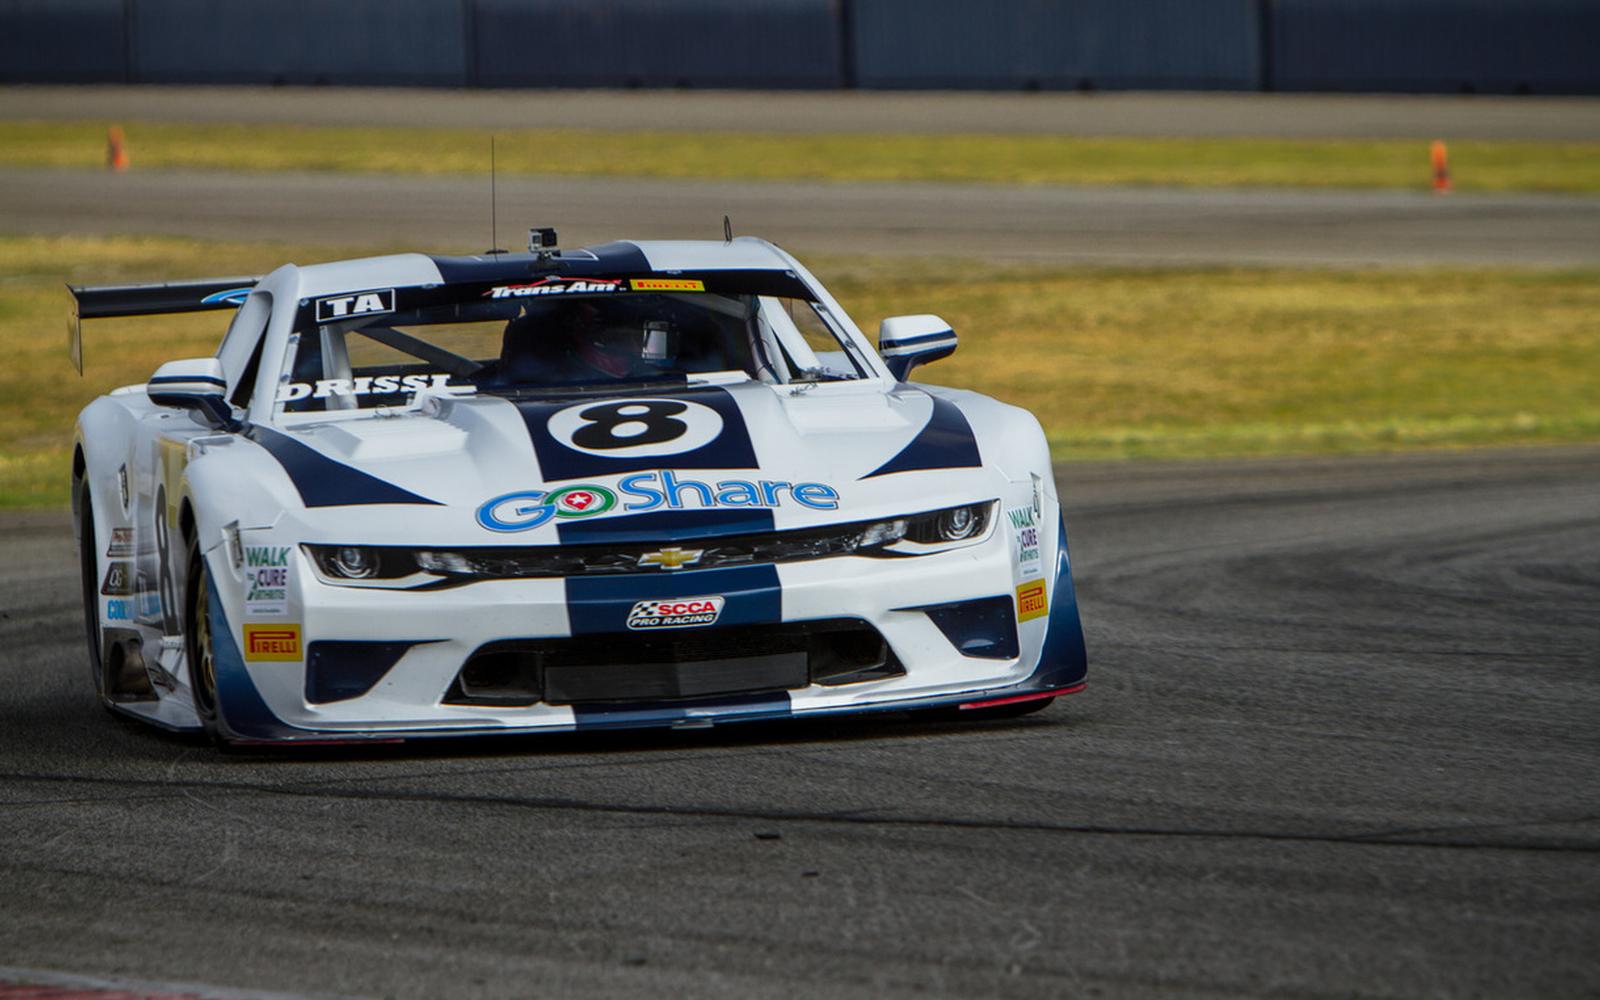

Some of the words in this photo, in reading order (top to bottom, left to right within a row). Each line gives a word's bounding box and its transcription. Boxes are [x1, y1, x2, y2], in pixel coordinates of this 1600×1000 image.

[491, 282, 565, 299] Trans
[566, 280, 617, 293] Am
[326, 293, 385, 317] TA
[275, 373, 453, 403] DRISSI
[571, 400, 689, 450] 8
[1008, 506, 1035, 530] WALK
[1021, 528, 1038, 548] CURE
[246, 546, 292, 568] WALK
[257, 568, 287, 588] CURE
[658, 600, 717, 616] SCCA
[1019, 586, 1045, 615] PIRELLI
[631, 616, 662, 628] PRO
[660, 613, 715, 626] RACING
[249, 631, 298, 653] PIRELLI
